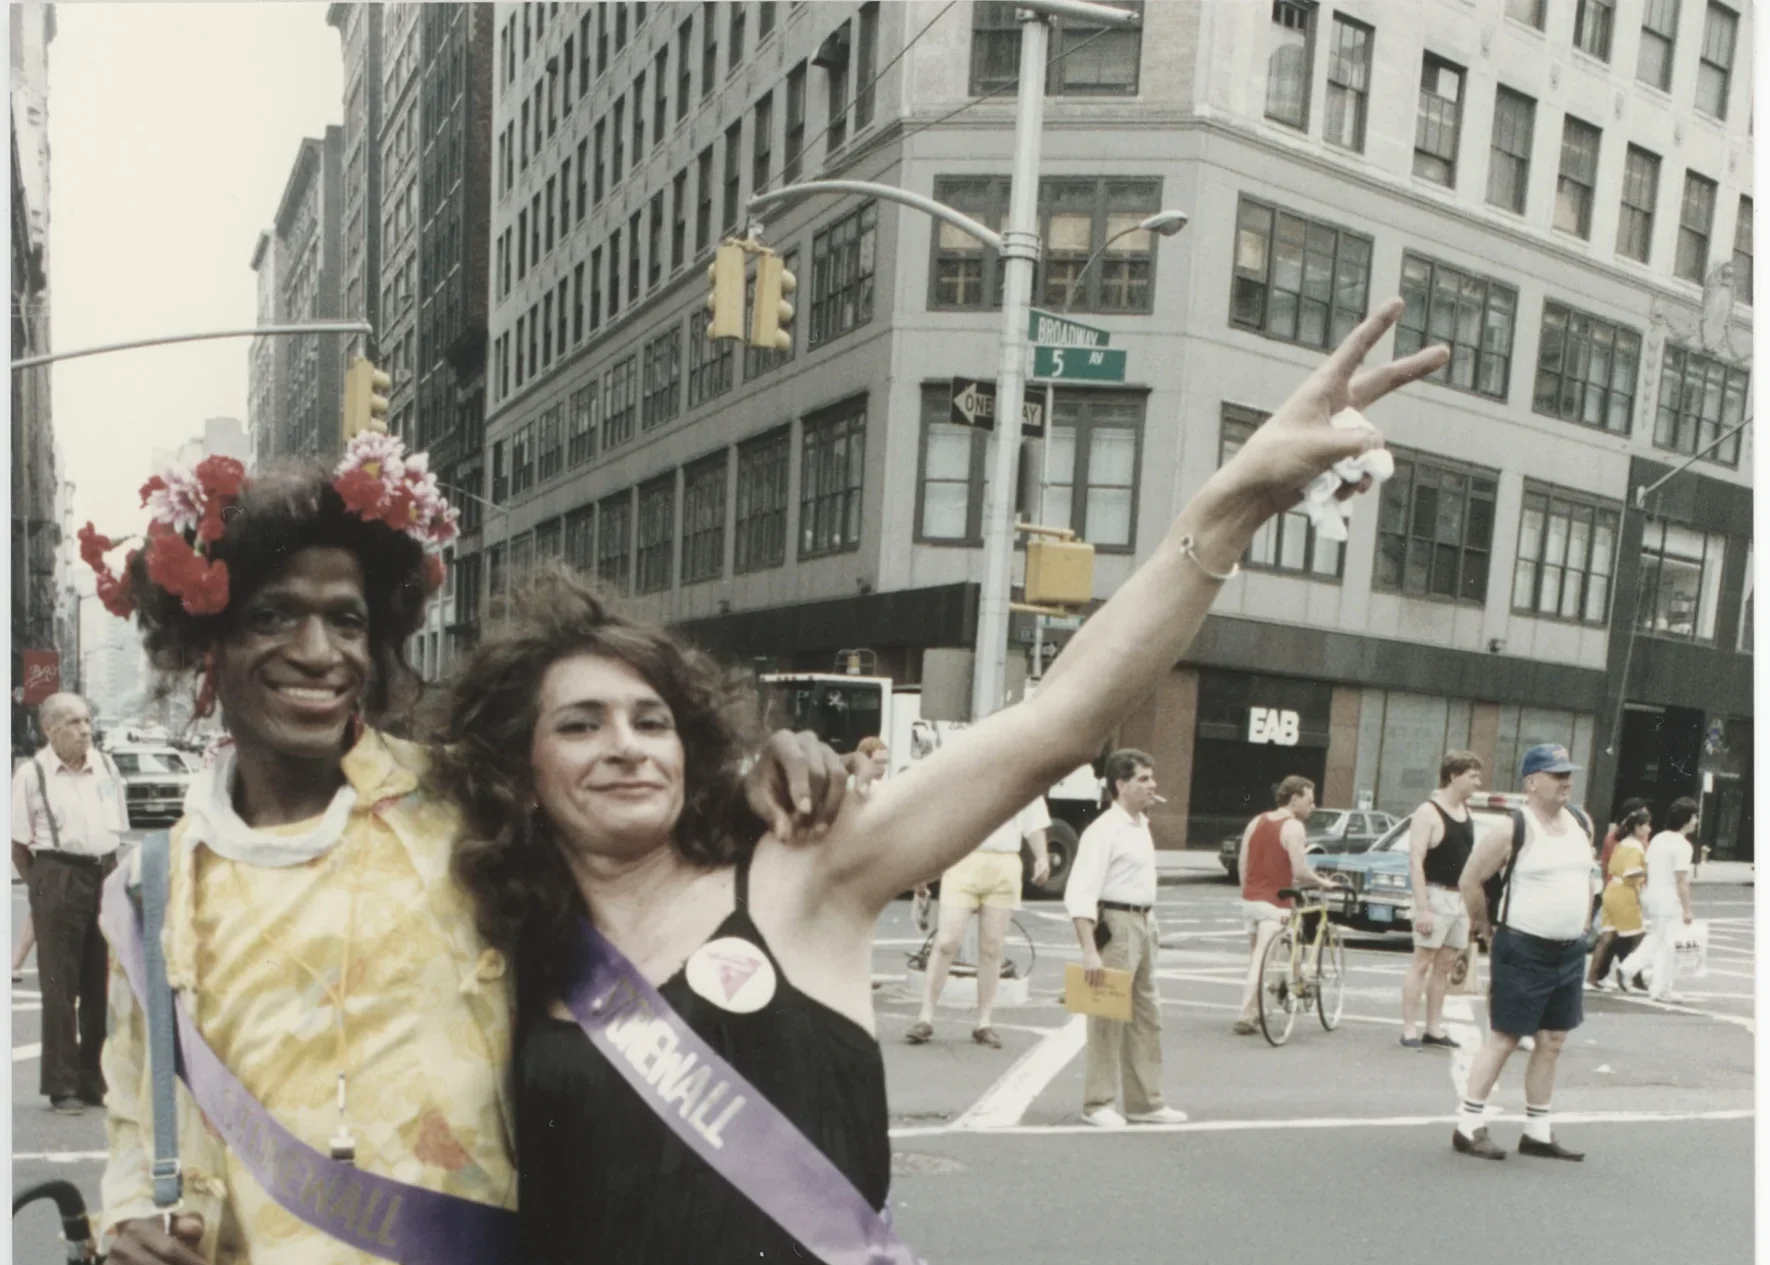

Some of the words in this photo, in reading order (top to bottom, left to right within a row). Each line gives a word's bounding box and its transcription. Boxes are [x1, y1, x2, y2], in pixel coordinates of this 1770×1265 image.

[1038, 316, 1099, 347] BROADWAY
[1051, 350, 1064, 378] 5
[1088, 351, 1105, 365] AV
[965, 394, 993, 416] ONE
[1021, 404, 1038, 424] AY
[1248, 707, 1300, 746] EAB
